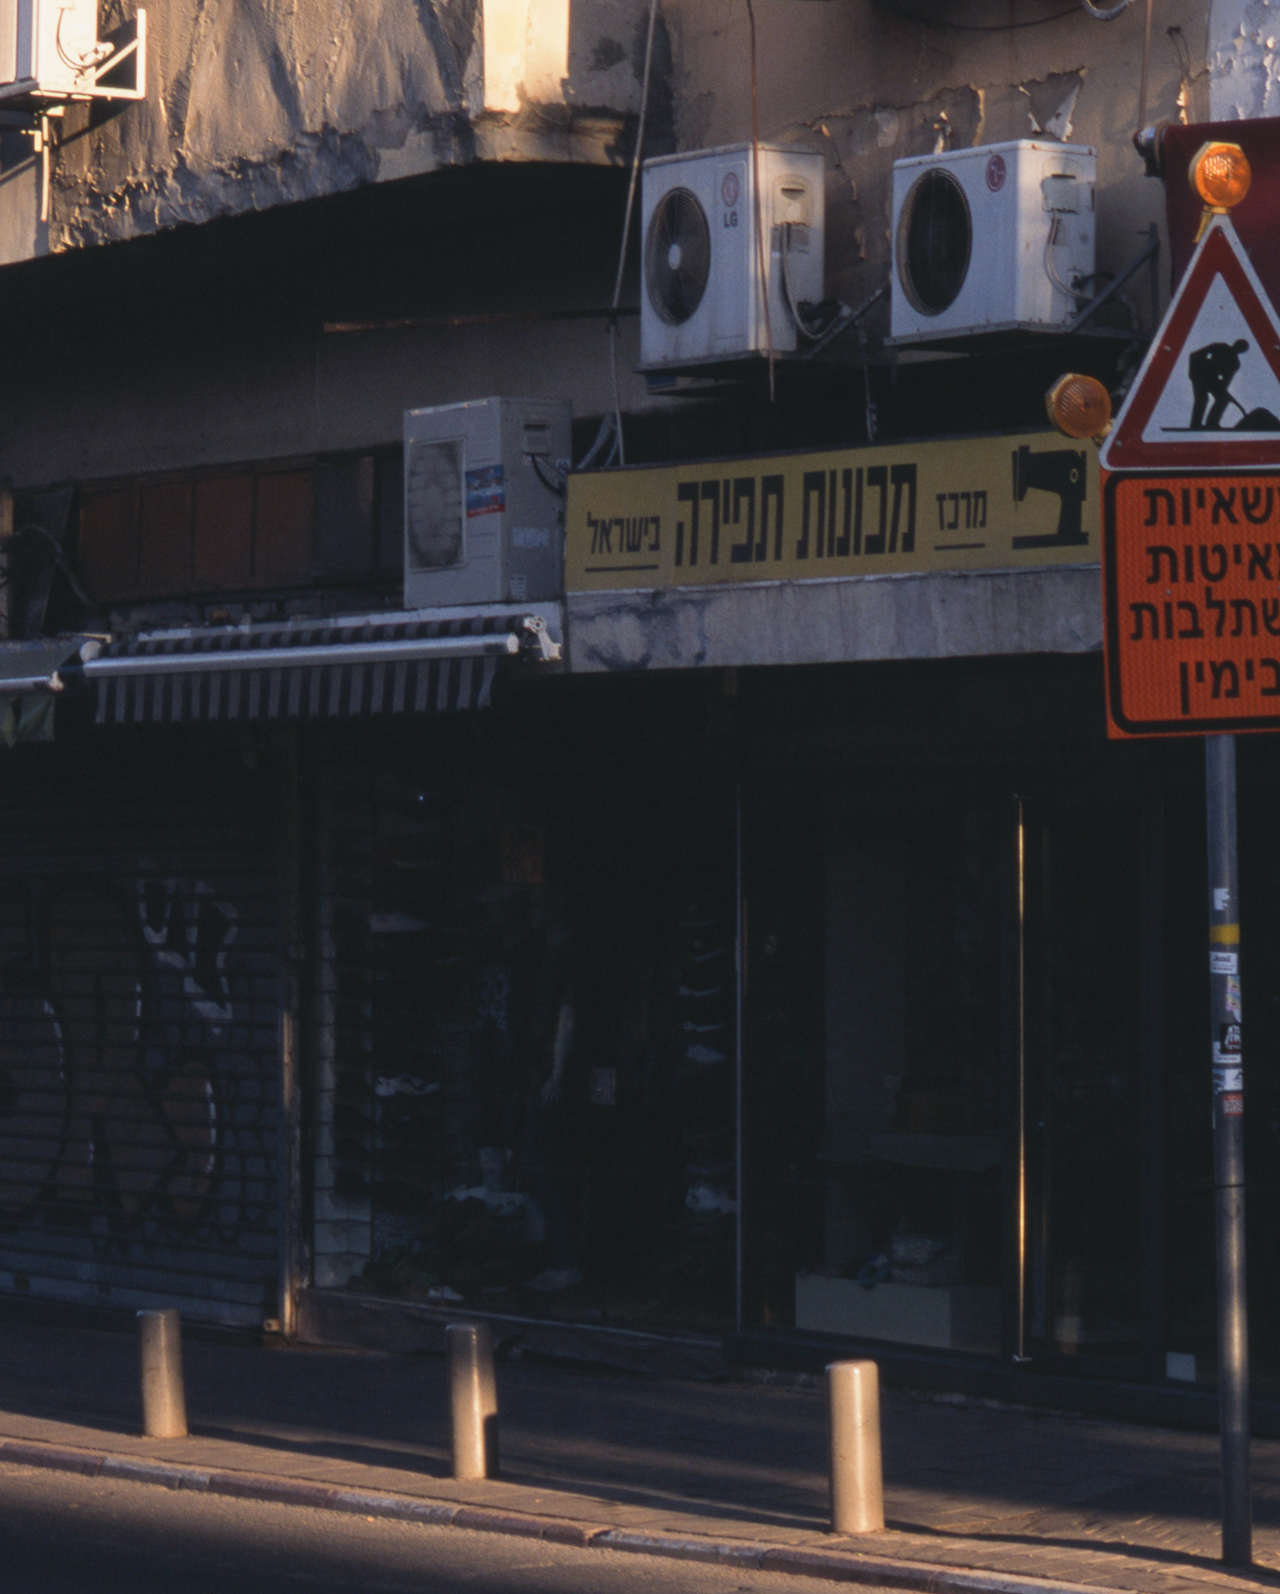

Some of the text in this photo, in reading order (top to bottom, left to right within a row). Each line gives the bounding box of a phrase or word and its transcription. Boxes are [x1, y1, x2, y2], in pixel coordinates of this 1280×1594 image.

[723, 212, 738, 228] LG
[586, 463, 987, 567] מרכז מכונות תפירה בישראל
